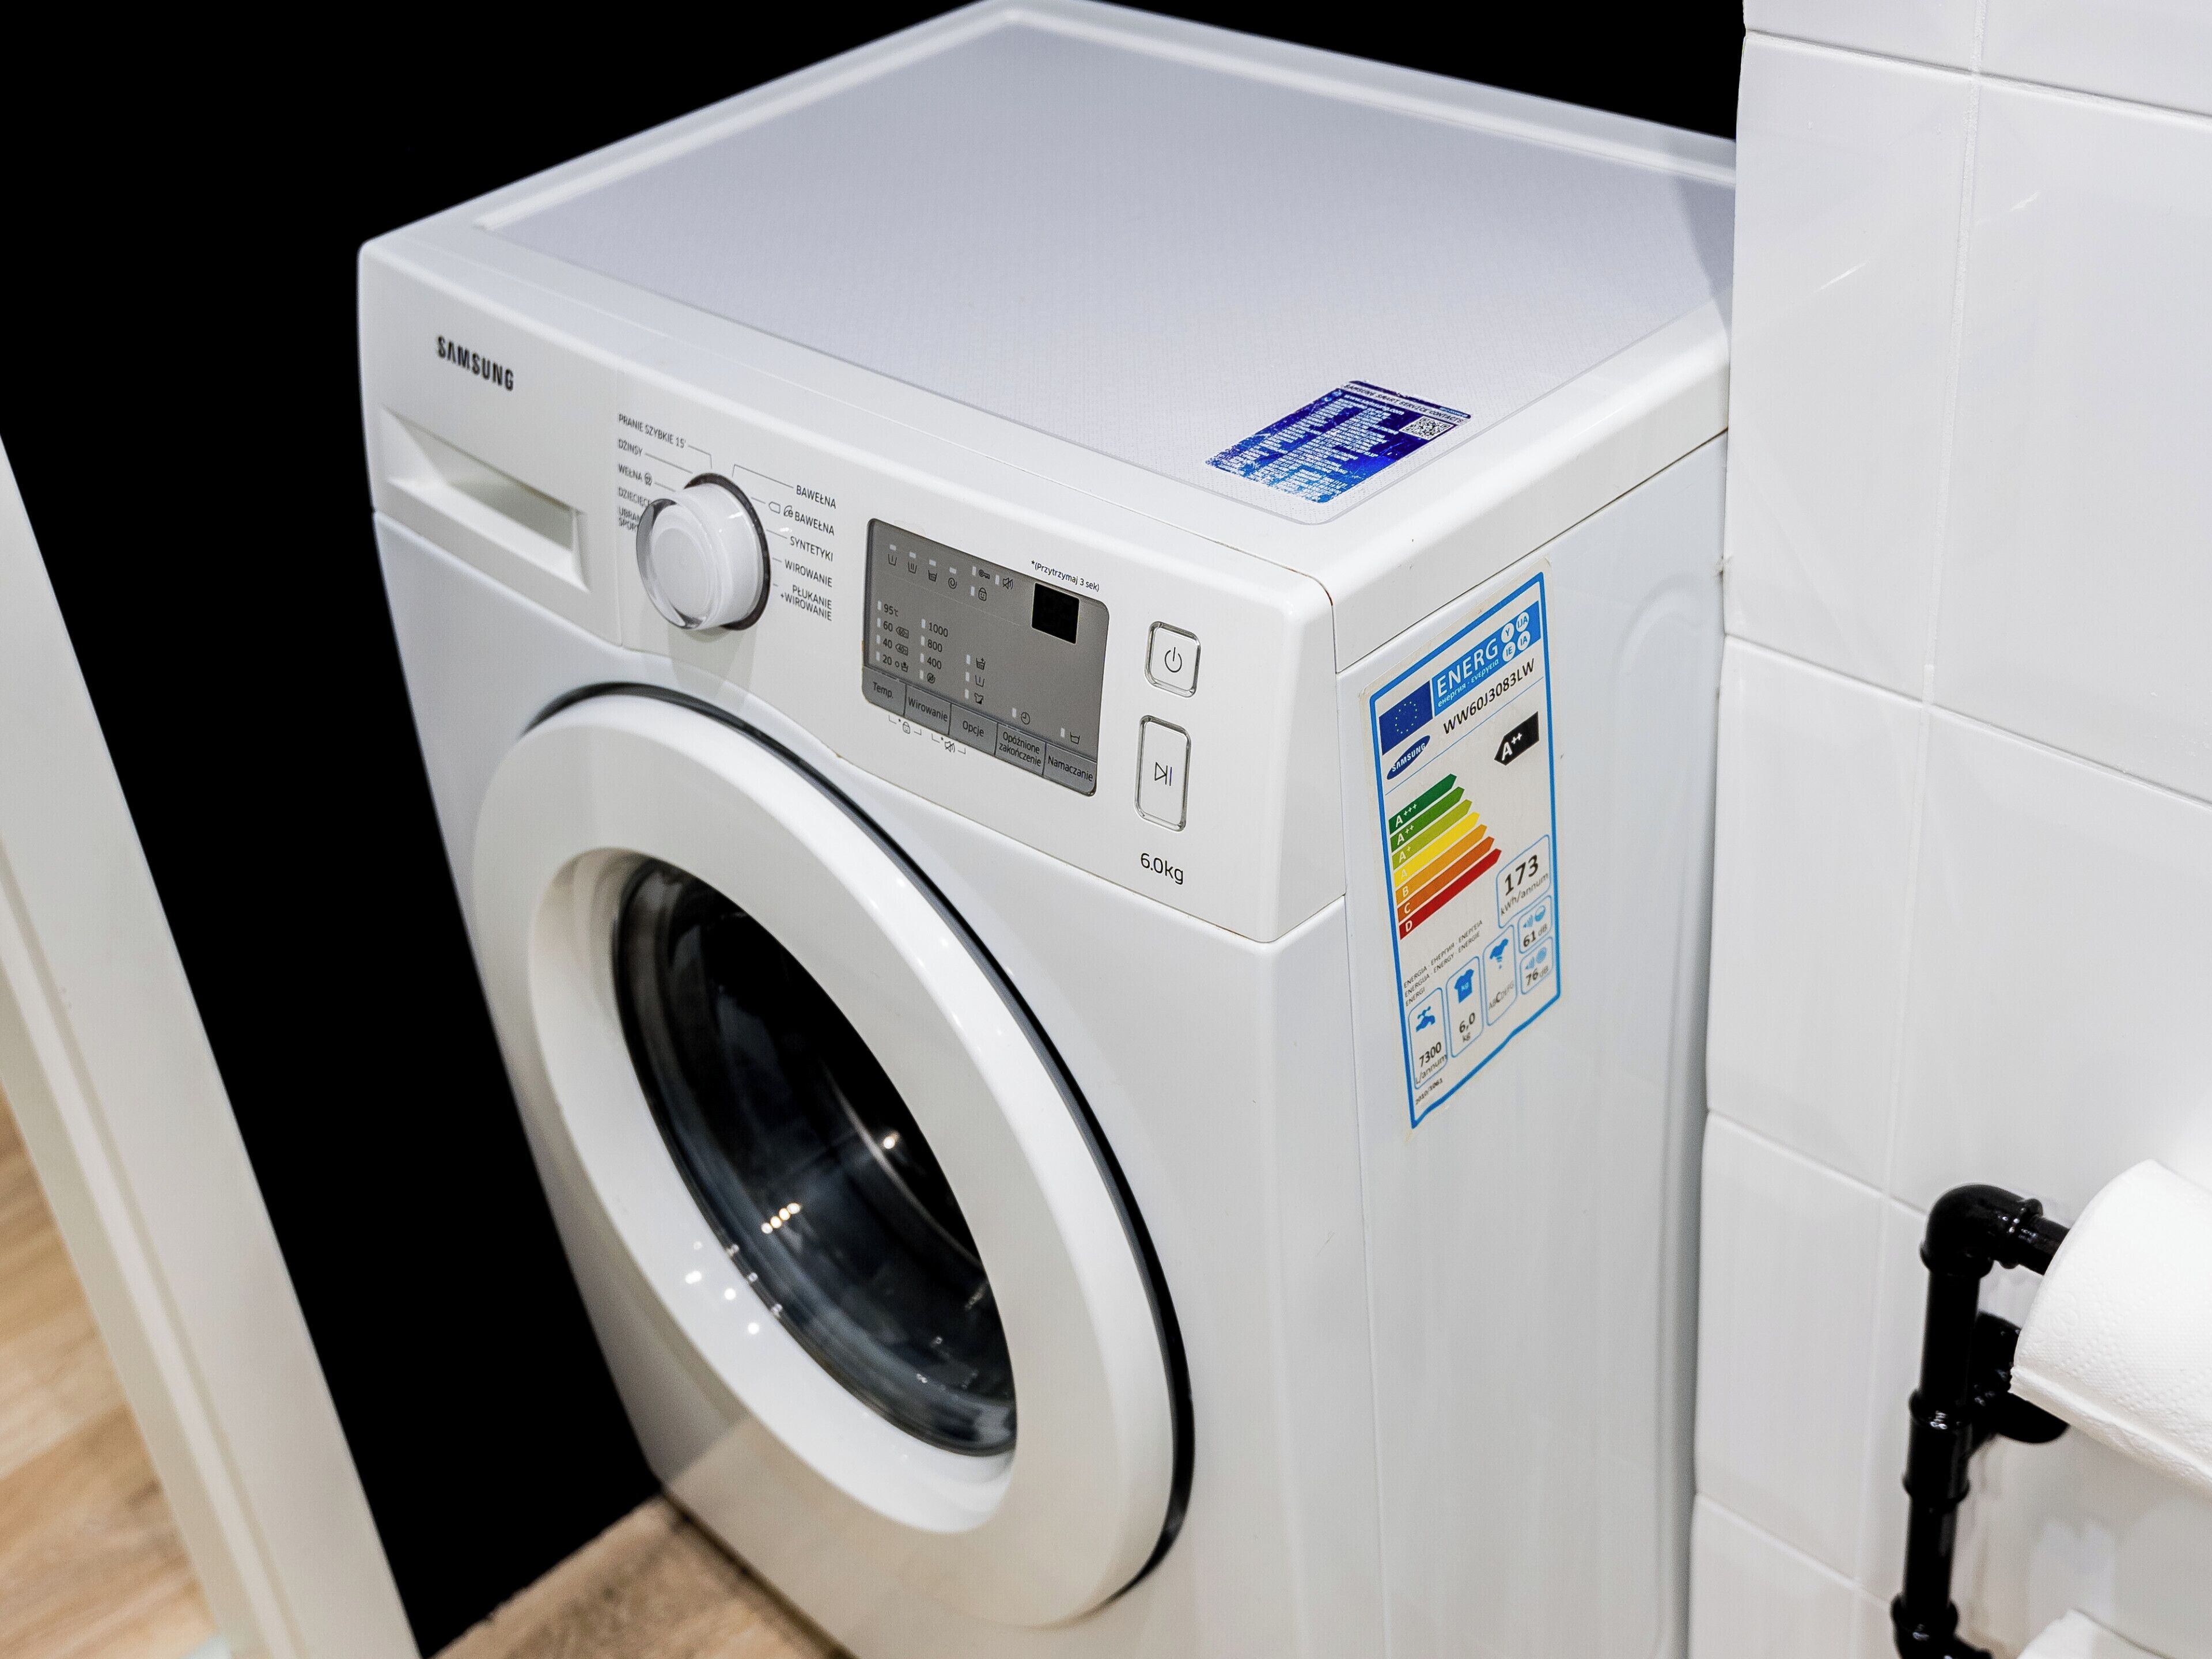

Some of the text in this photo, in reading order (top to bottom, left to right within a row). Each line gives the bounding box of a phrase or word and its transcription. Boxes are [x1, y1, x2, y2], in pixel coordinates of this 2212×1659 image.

[438, 335, 514, 391] SAMSUNG
[1399, 401, 1430, 414] SERVICE
[1429, 410, 1464, 424] CONTACTS
[619, 414, 643, 433] PRANIE
[645, 425, 673, 445] SZYBKIE
[619, 464, 642, 482] WEŁNA
[796, 484, 836, 509] BAWEŁNA
[795, 511, 835, 536] BAWEŁNA
[790, 536, 833, 562] SYNTETYKI
[785, 559, 832, 588] WIROWANIE
[1080, 578, 1085, 586] 3
[1085, 581, 1100, 592] sek)
[793, 585, 832, 610] PŁUKANIE
[883, 621, 893, 632] 60
[929, 622, 948, 637] 1000
[1505, 628, 1510, 637] Y
[882, 638, 892, 649] 40
[927, 639, 943, 653] 800
[1506, 646, 1513, 657] IE
[1520, 636, 1528, 646] IA
[882, 654, 892, 665] 20
[927, 657, 942, 669] 400
[1437, 638, 1498, 698] ENERG
[873, 681, 893, 699] Temp.
[1443, 658, 1534, 734] WW60J3083LW
[908, 696, 948, 722] Wirowanie
[962, 721, 984, 737] Opcje
[1003, 731, 1040, 755] Opóźnione
[1501, 732, 1522, 761] A++
[999, 742, 1041, 767] zakończenie
[1392, 743, 1426, 772] SAMSUNG
[1048, 755, 1093, 782] Namaczanie
[1395, 803, 1418, 828] A+++
[1397, 824, 1414, 846] A++
[1399, 846, 1411, 863] A+
[1141, 853, 1184, 885] 6.0kg
[1401, 868, 1407, 879] A
[1505, 854, 1539, 896] 173
[1402, 886, 1409, 897] B
[1501, 873, 1549, 916] kWh/annum
[1404, 903, 1411, 914] C
[1405, 920, 1412, 933] D
[1538, 923, 1548, 937] dB
[1523, 930, 1536, 948] 61
[1433, 952, 1455, 974] ENERGY
[1458, 931, 1480, 953] ENERGIE
[1404, 965, 1427, 988] ENERGIA
[1525, 968, 1539, 986] 76
[1406, 987, 1425, 1007] ENERGI
[1459, 1012, 1475, 1033] 6,0
[1419, 1041, 1442, 1068] 7300
